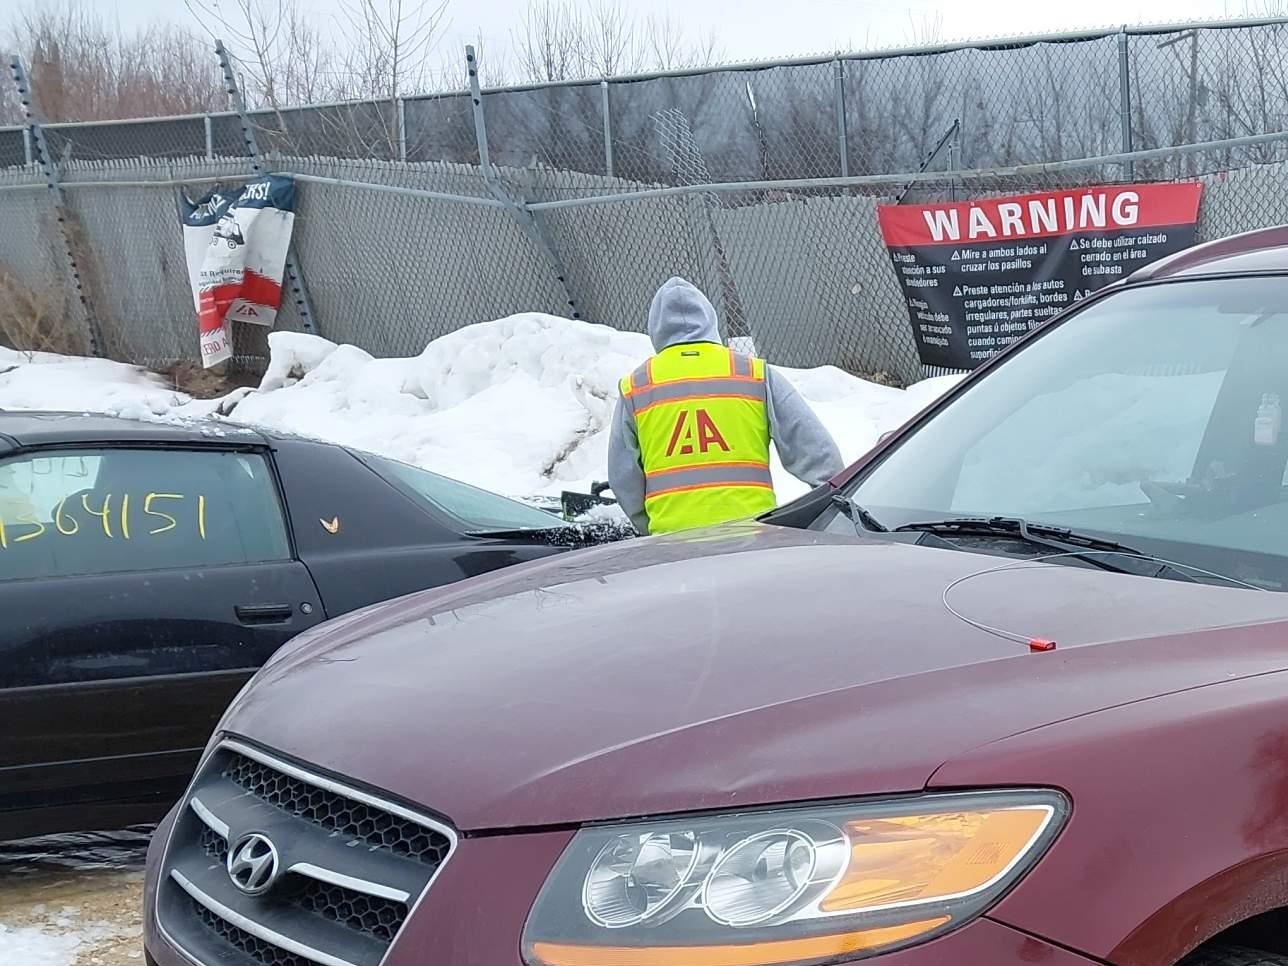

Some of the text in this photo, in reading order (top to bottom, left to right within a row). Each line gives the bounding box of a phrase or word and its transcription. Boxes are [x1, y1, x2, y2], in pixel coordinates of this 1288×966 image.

[923, 190, 1140, 241] WARNING
[1080, 232, 1167, 249] Se debe utilizar calzado
[961, 243, 1048, 260] Mire a ambos lados al
[1081, 251, 1111, 262] cerrado
[1113, 251, 1122, 260] en
[1123, 248, 1129, 259] el
[932, 265, 946, 274] sus
[961, 259, 1033, 272] cruzar los pasillos
[1082, 264, 1122, 276] de subasta
[962, 285, 989, 295] Preste
[990, 282, 1025, 294] atención
[1032, 281, 1042, 291] los
[1042, 280, 1065, 290] autos
[1039, 292, 1068, 303] bordes
[965, 310, 1010, 323] irregulares,
[1010, 308, 1033, 321] partes
[966, 324, 993, 336] puntas
[1000, 321, 1027, 334] objetos
[968, 336, 995, 347] cuando
